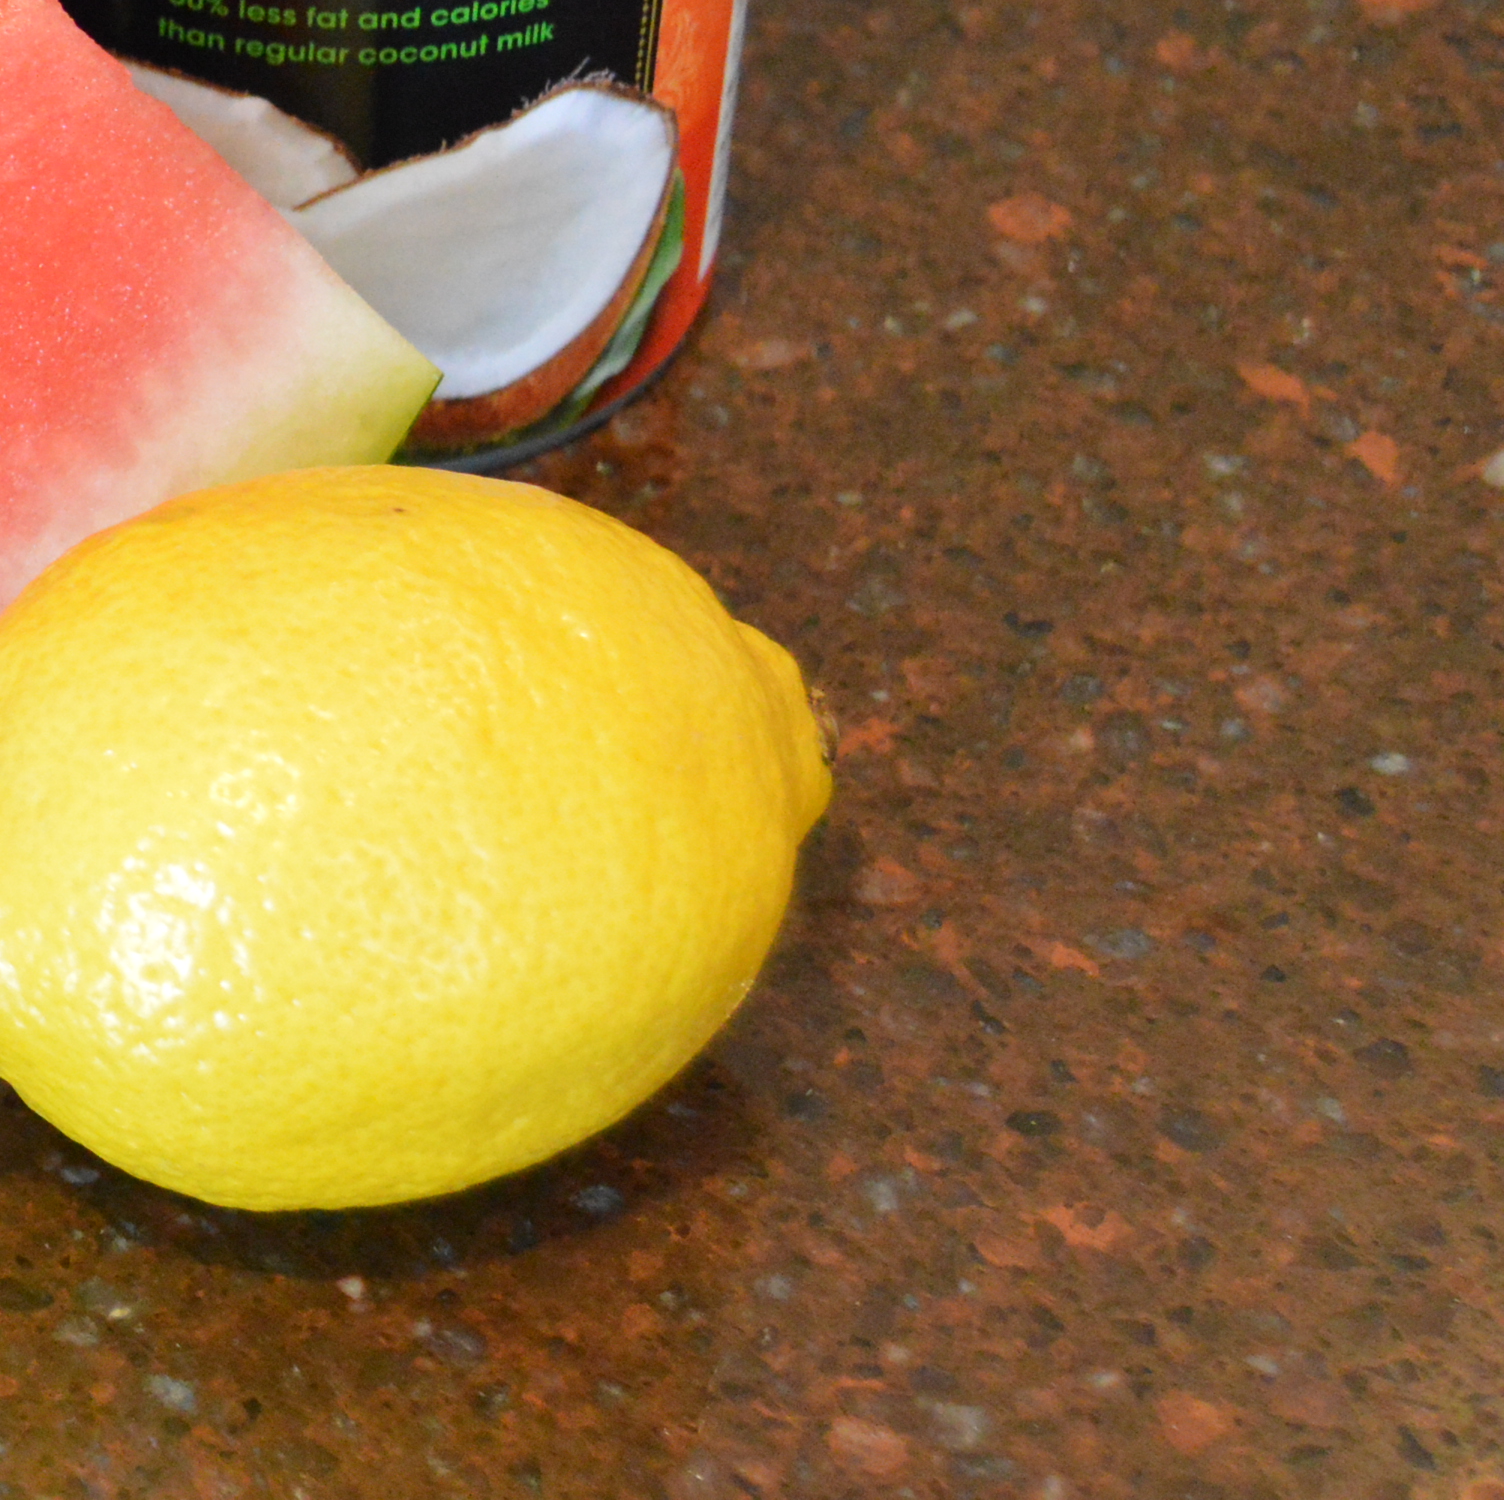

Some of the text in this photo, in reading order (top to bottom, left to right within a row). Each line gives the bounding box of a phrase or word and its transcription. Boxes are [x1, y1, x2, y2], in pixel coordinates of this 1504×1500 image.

[306, 6, 348, 30] fat
[358, 7, 421, 31] and
[158, 17, 555, 66] than regular coconut milk
